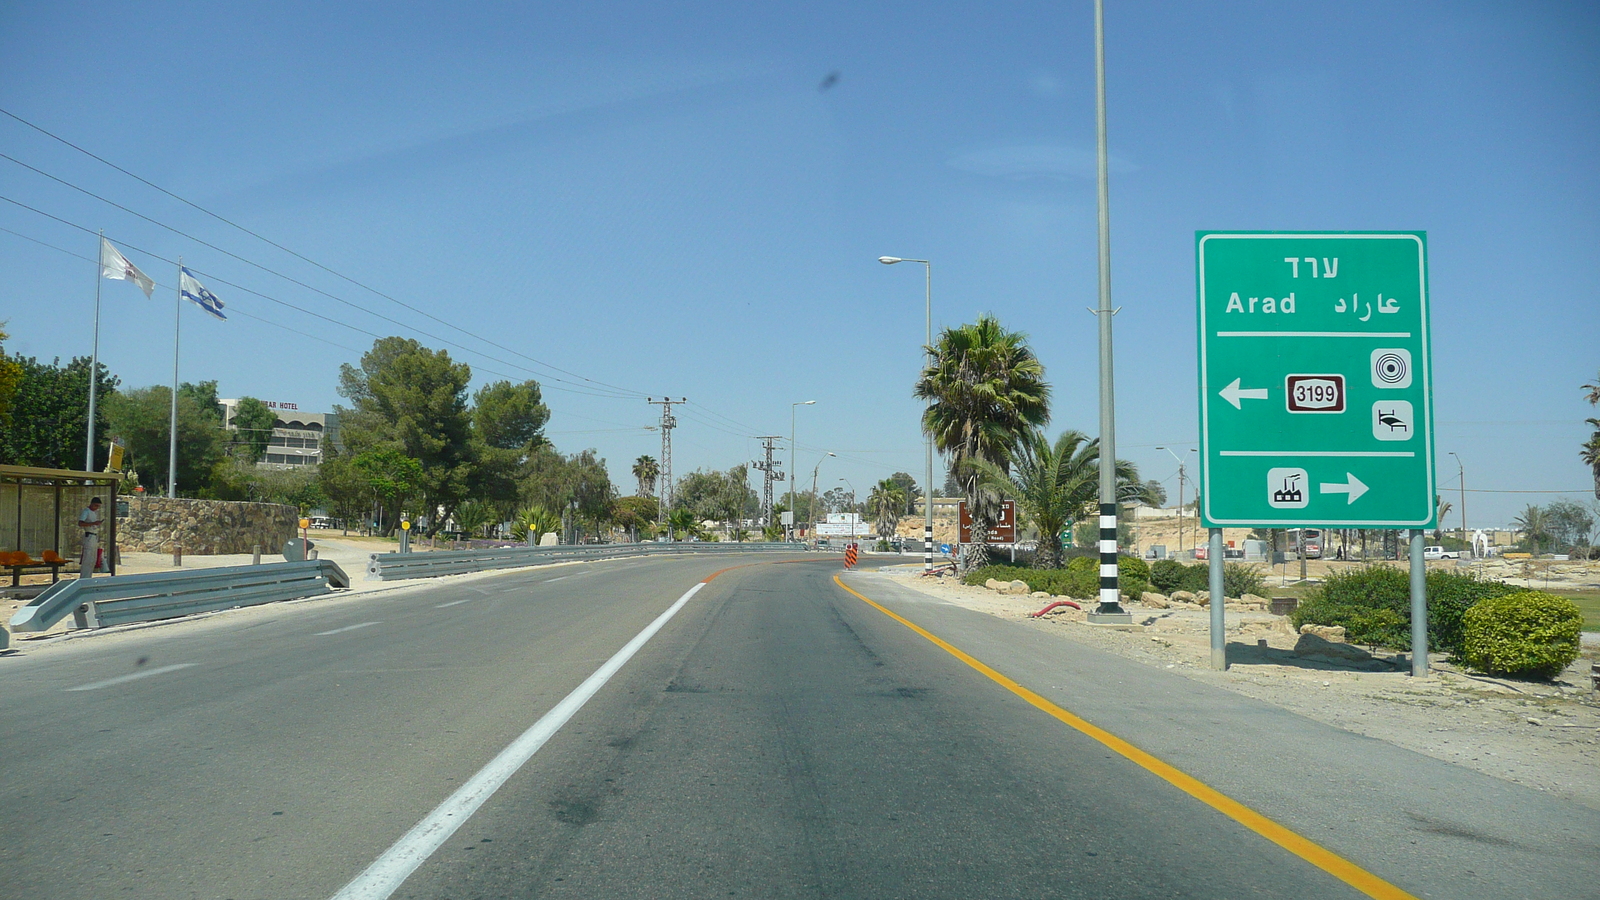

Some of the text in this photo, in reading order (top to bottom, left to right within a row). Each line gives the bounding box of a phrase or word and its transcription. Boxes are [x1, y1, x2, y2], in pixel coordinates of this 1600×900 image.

[1284, 257, 1339, 279] ערד
[1225, 292, 1296, 313] Arad
[1334, 292, 1401, 322] عاراد
[1296, 385, 1335, 402] 3199
[279, 402, 298, 410] HOTEL
